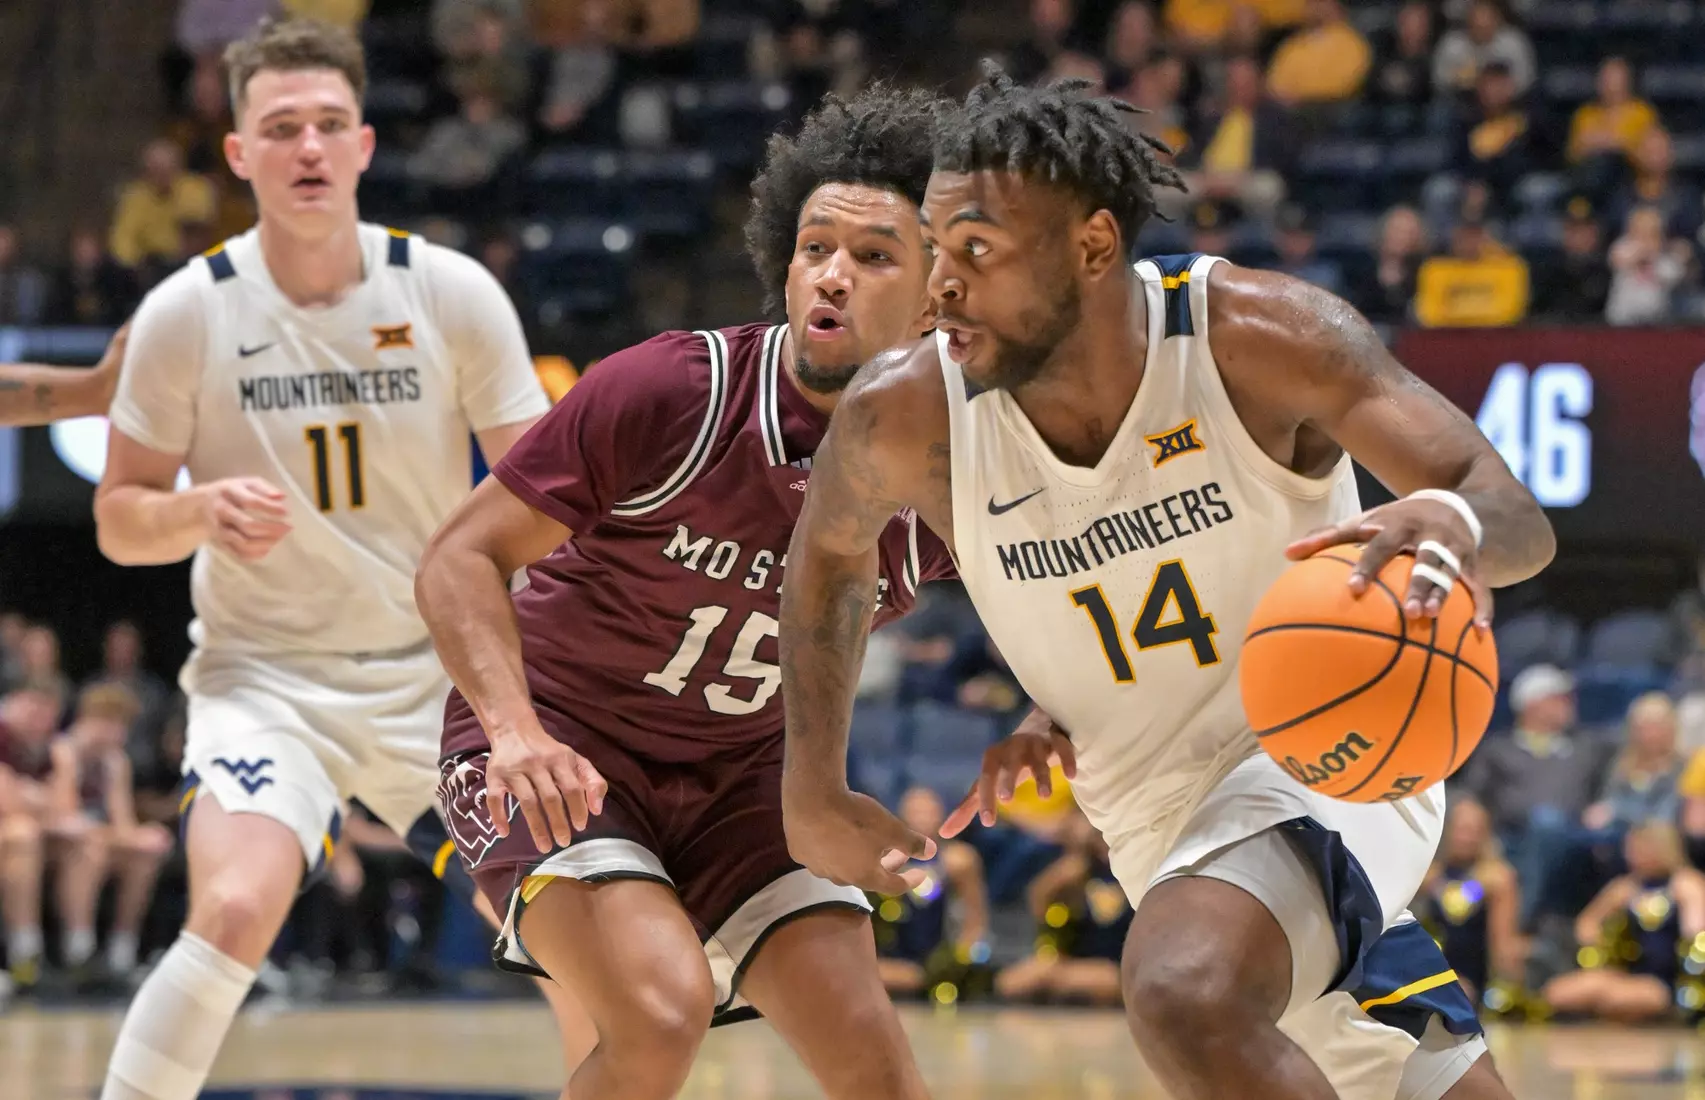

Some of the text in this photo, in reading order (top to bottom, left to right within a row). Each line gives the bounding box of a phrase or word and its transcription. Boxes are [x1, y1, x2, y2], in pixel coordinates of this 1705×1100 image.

[239, 367, 422, 411] MOUNTAINEERS
[1474, 361, 1594, 508] 46
[304, 421, 365, 513] 11
[662, 524, 741, 580] MO
[996, 481, 1234, 582] MOUNTAINEERS
[642, 605, 783, 715] 15
[1068, 557, 1222, 684] 14
[1284, 731, 1375, 786] lson
